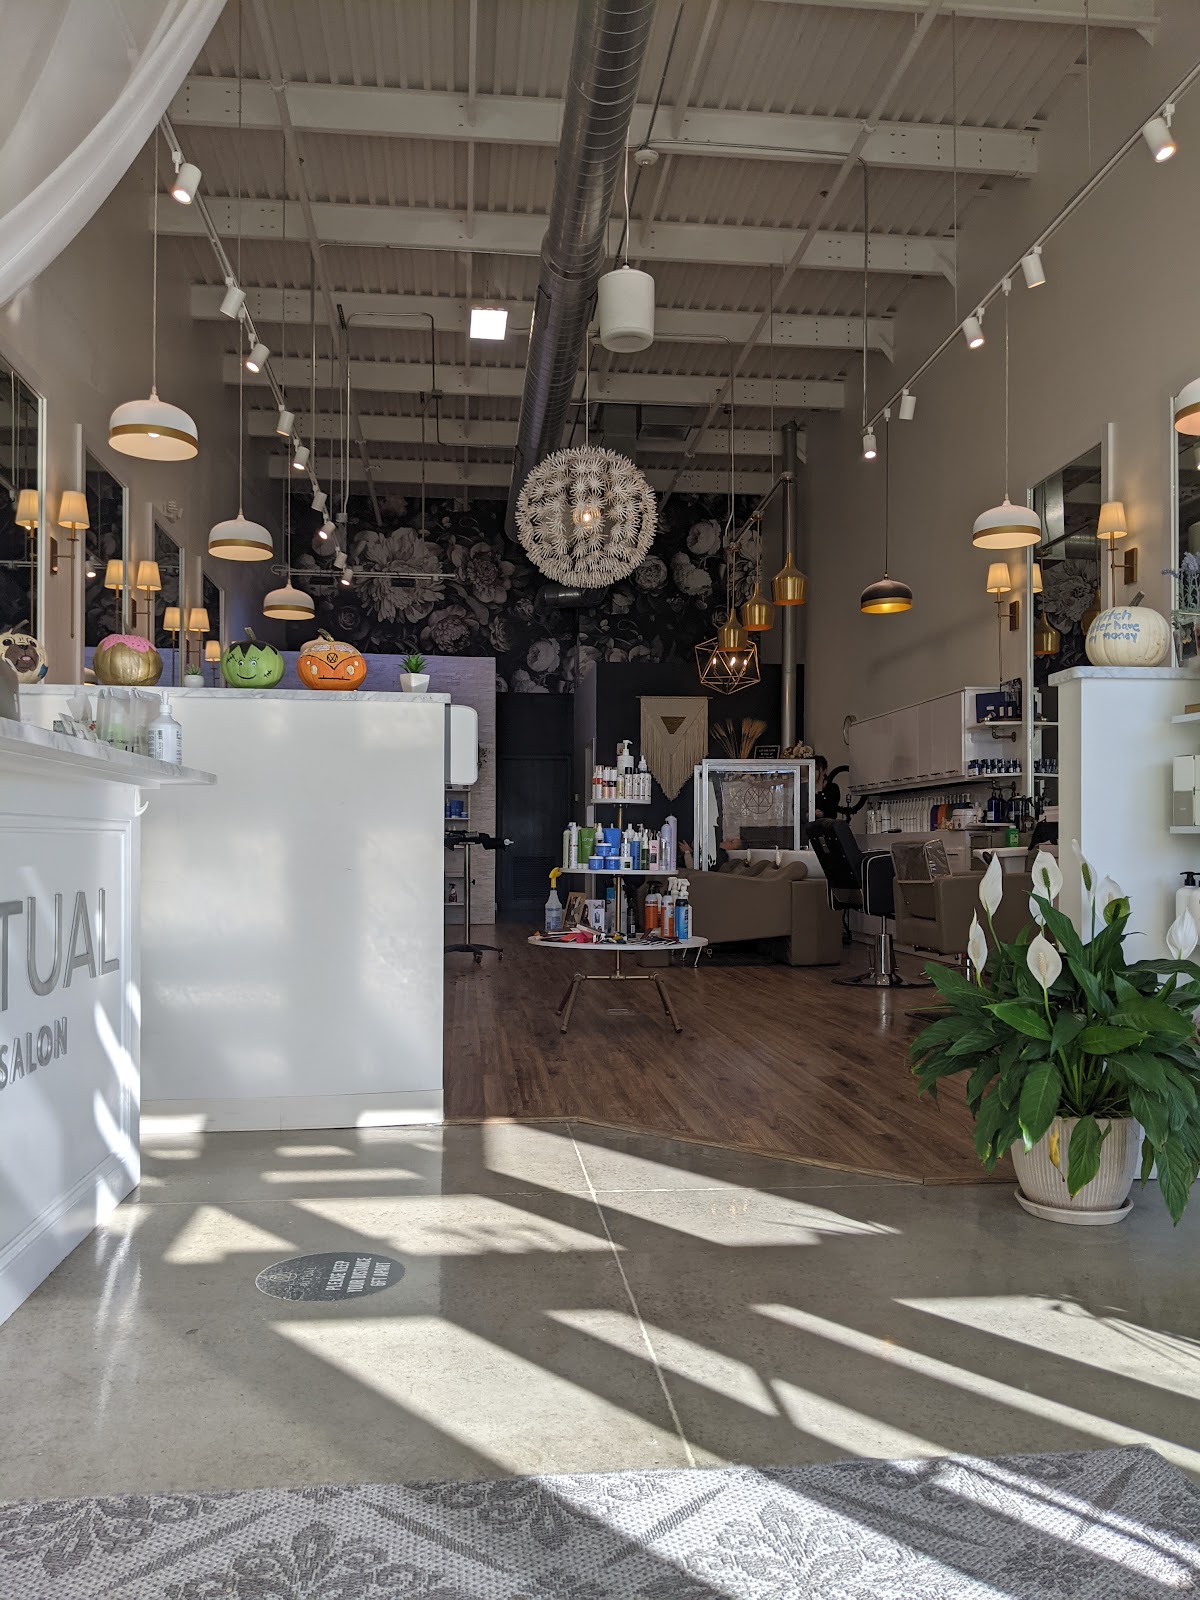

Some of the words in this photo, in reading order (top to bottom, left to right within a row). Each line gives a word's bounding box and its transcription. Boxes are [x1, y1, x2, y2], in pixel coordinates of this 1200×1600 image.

[1114, 621, 1140, 632] have
[1103, 632, 1137, 643] money
[0, 1016, 68, 1090] SALON
[332, 1260, 350, 1272] KEEP
[350, 1257, 372, 1279] DISTANCE
[372, 1262, 391, 1277] APART
[325, 1273, 346, 1291] PLEASE
[346, 1279, 365, 1293] YOUR
[370, 1277, 388, 1287] 6FT
